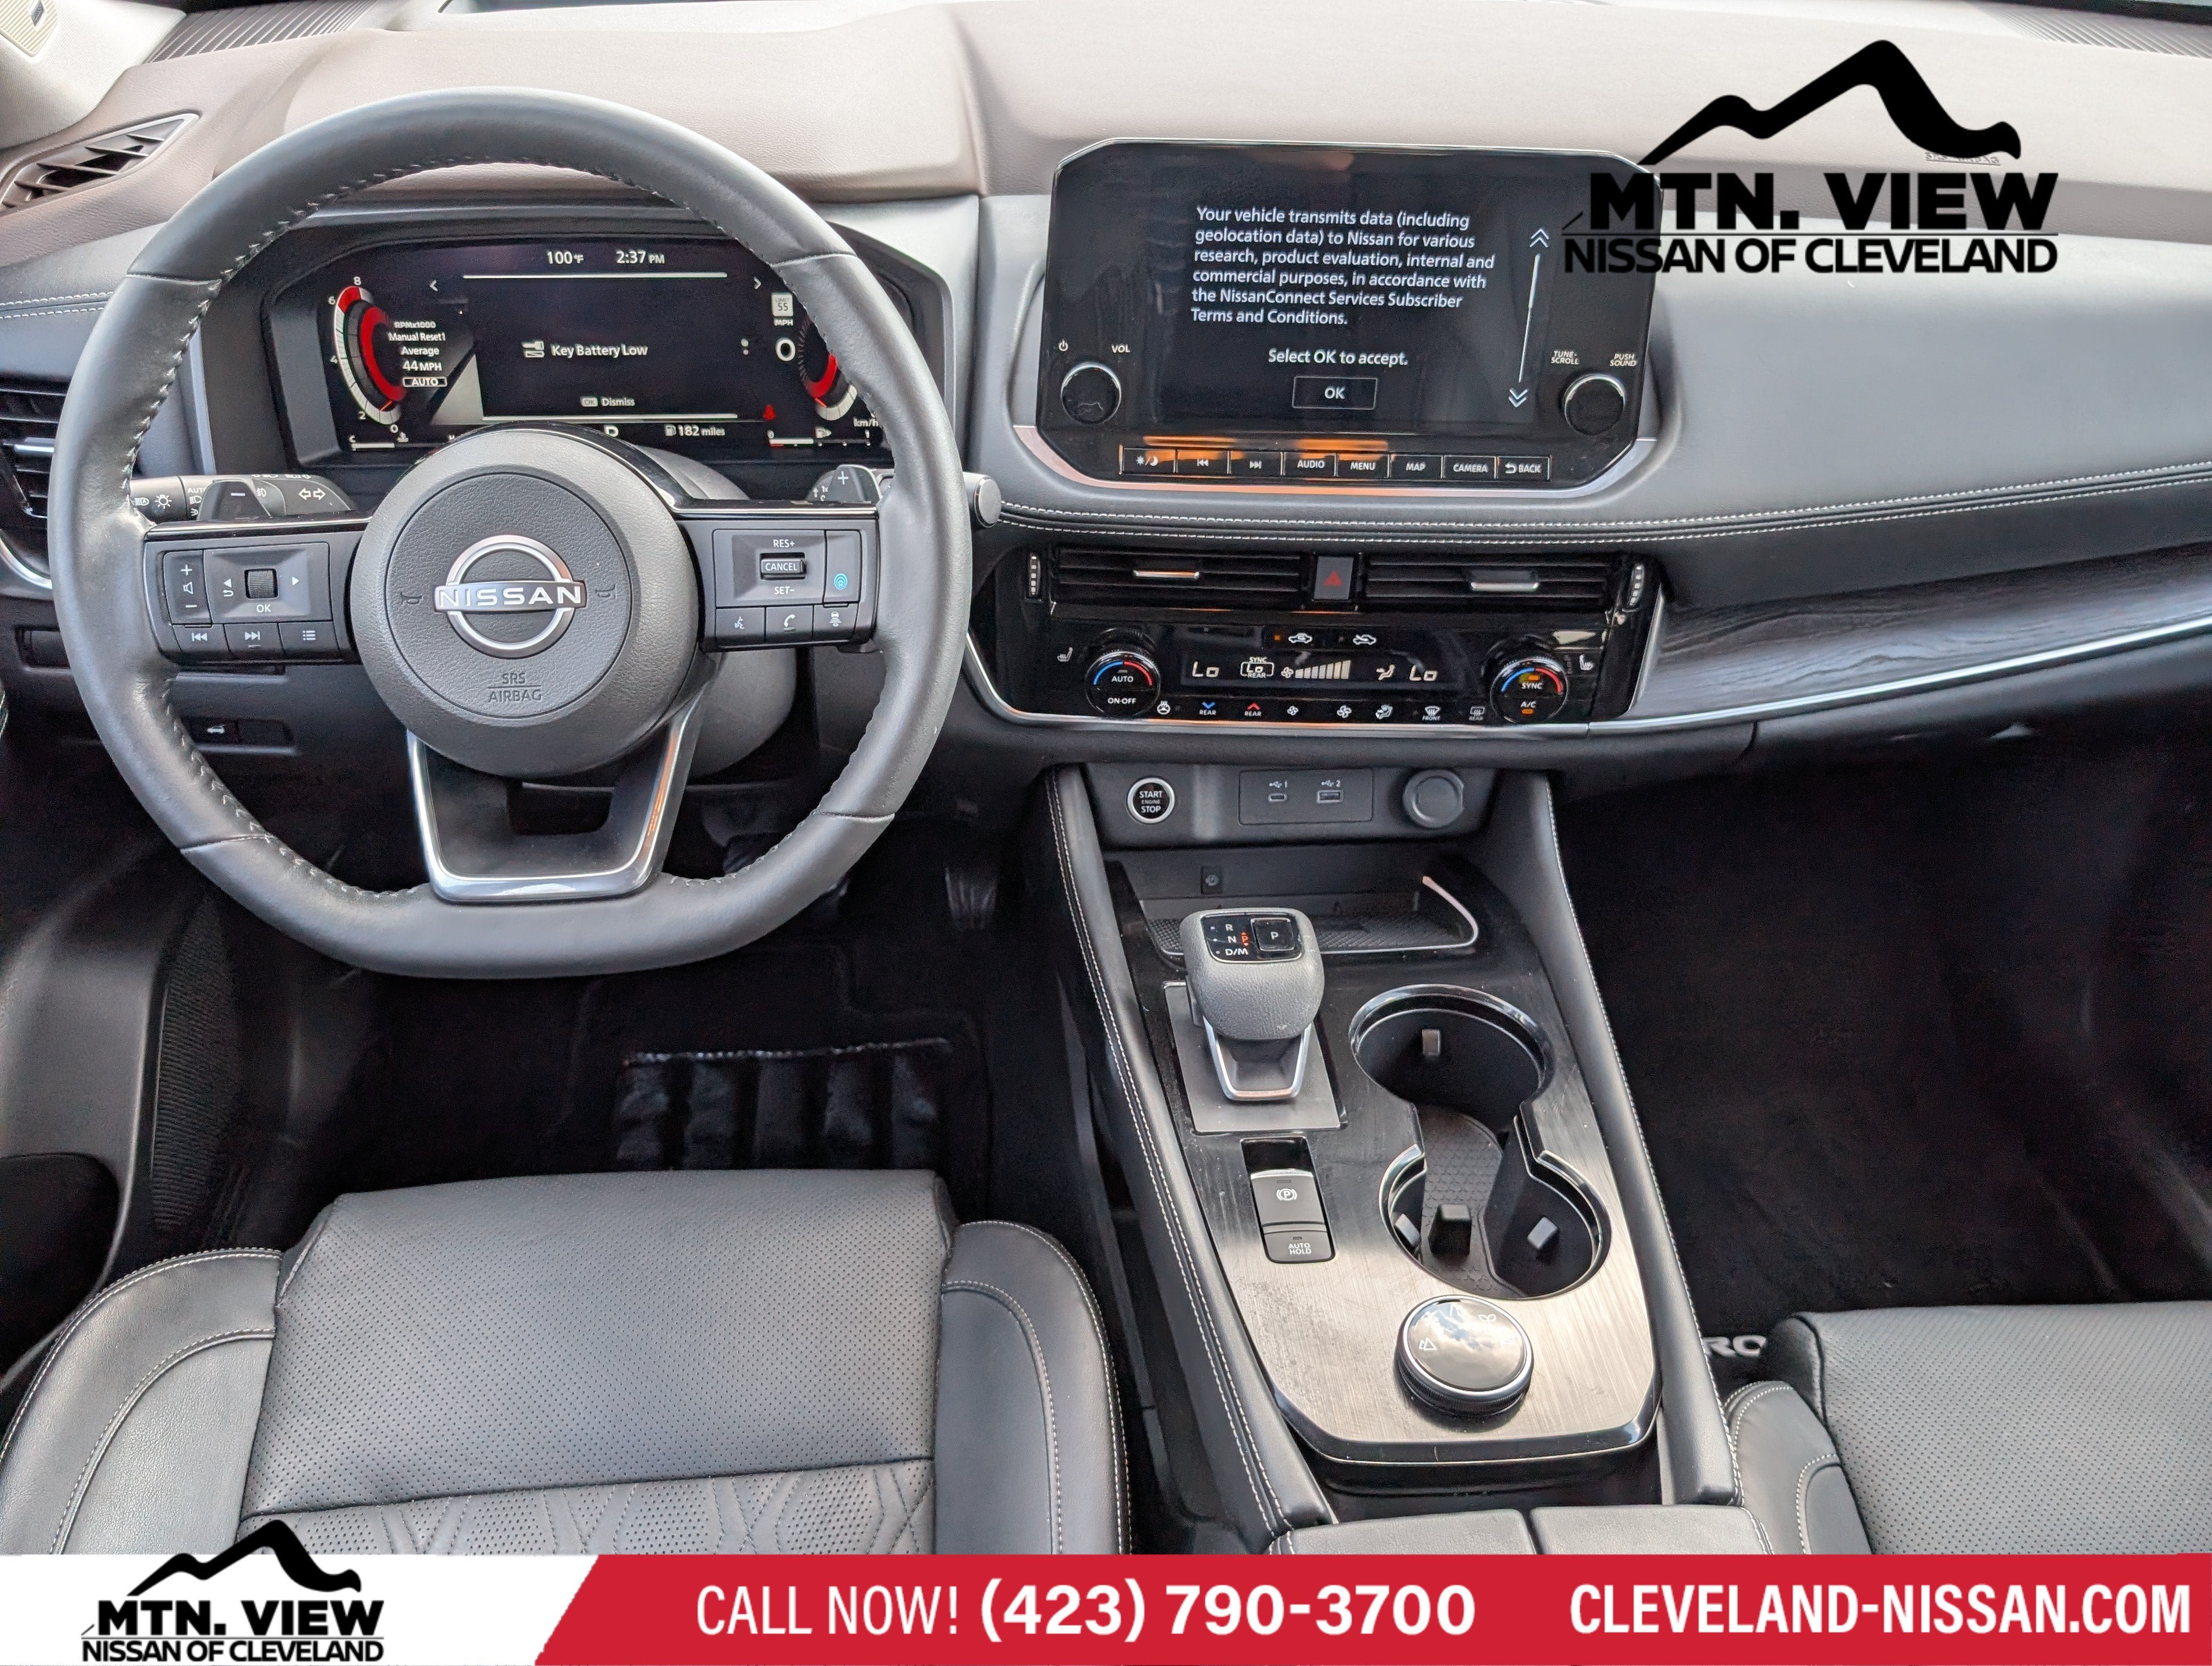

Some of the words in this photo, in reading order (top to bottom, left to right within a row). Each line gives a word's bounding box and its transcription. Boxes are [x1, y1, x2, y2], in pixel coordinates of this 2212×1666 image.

[1196, 207, 1231, 222] Your
[1234, 207, 1285, 223] vehicle
[1288, 209, 1356, 225] transmits
[1360, 210, 1393, 226] data
[1397, 210, 1470, 230] (including
[1195, 228, 1282, 245] geolocation
[1285, 229, 1324, 246] data)
[1327, 232, 1343, 245] to
[1348, 233, 1393, 246] Nissan
[1397, 232, 1420, 247] for
[1423, 234, 1475, 248] various
[616, 249, 646, 264] 2:37
[648, 254, 665, 264] PM
[1194, 248, 1258, 265] research,
[1262, 250, 1319, 266] product
[1322, 251, 1403, 268] evaluation,
[1406, 253, 1463, 268] internal
[1466, 254, 1495, 269] and
[354, 277, 361, 286] 8
[1193, 269, 1276, 284] commercial
[1279, 272, 1349, 287] purposes,
[1352, 273, 1366, 285] in
[1368, 273, 1450, 288] accordance
[1454, 274, 1487, 289] with
[328, 296, 336, 305] 6
[1192, 289, 1217, 302] the
[1220, 290, 1326, 305] NissanConnect
[1328, 291, 1385, 306] Services
[1388, 293, 1463, 308] Subscriber
[777, 303, 788, 311] 55
[1191, 308, 1233, 322] Terms
[1236, 309, 1264, 323] and
[1267, 309, 1348, 325] Conditions.
[388, 332, 419, 341] Manual
[401, 346, 440, 357] Average
[550, 344, 574, 358] Key
[575, 343, 620, 358] Battery
[621, 343, 648, 356] Low
[776, 337, 795, 361] 0
[1111, 344, 1130, 354] VOL
[1268, 348, 1311, 363] Select
[1314, 350, 1336, 363] OK
[1340, 351, 1355, 364] to
[1358, 351, 1409, 368] accept.
[402, 360, 419, 371] 44
[419, 362, 442, 371] MPH
[1324, 387, 1345, 399] OK
[601, 397, 635, 406] Dismiss
[358, 412, 366, 420] 2
[853, 417, 879, 427] km/h
[390, 424, 398, 433] 0
[678, 425, 699, 436] 182
[700, 426, 725, 436] miles
[1297, 459, 1325, 470] AUDIO
[1350, 462, 1376, 471] MENU
[1405, 463, 1426, 471] MAP
[1453, 464, 1489, 473] CAMERA
[1519, 464, 1542, 473] BACK
[773, 539, 795, 548] RES+
[765, 562, 798, 572] CANCEL
[439, 586, 581, 608] NISSAN
[256, 604, 271, 613] OK
[502, 672, 525, 685] SRS
[488, 689, 542, 703] AIRBAG
[1270, 931, 1279, 940] P
[1225, 948, 1249, 956] D/M
